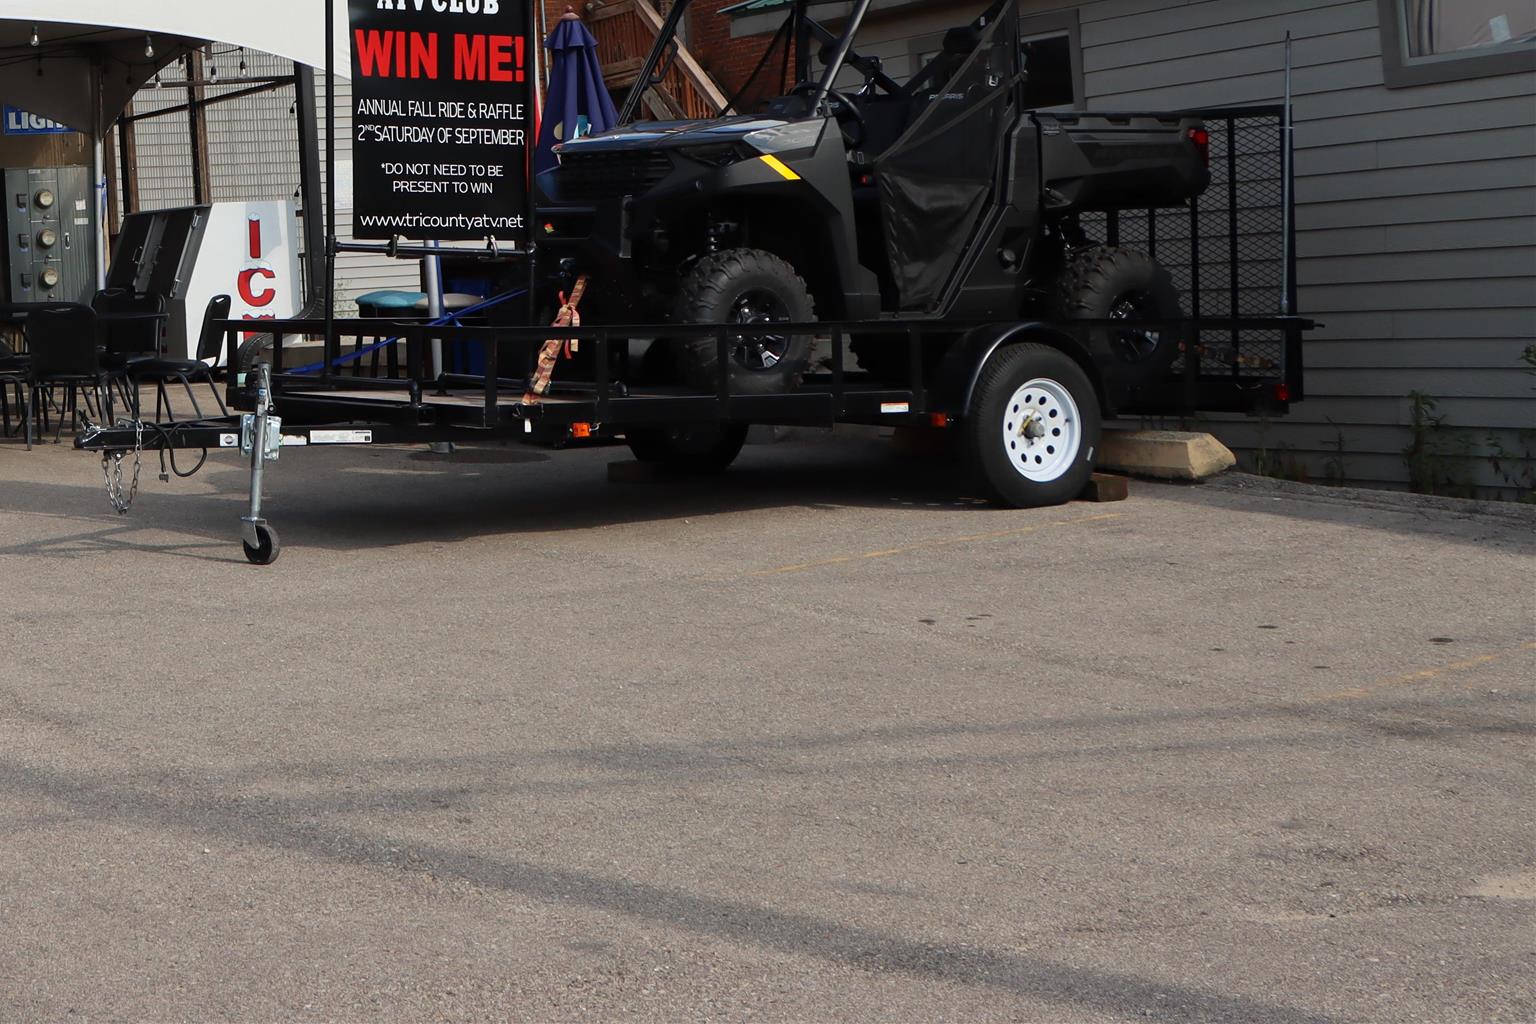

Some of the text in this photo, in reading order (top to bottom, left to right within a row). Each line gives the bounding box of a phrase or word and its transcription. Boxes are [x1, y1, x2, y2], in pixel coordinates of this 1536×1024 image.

[354, 29, 525, 83] WIN ME!
[357, 98, 525, 120] ANNUAL FALL RIDE & RAFFLE
[357, 124, 525, 146] 2ND SATURDAY OF SEPTEMBER
[405, 163, 431, 176] NOT
[433, 164, 467, 176] NEED
[469, 164, 485, 177] TO
[487, 165, 504, 177] BE
[392, 180, 493, 194] PRESENT TO WIN
[360, 212, 525, 230] www.tricountyatv.net
